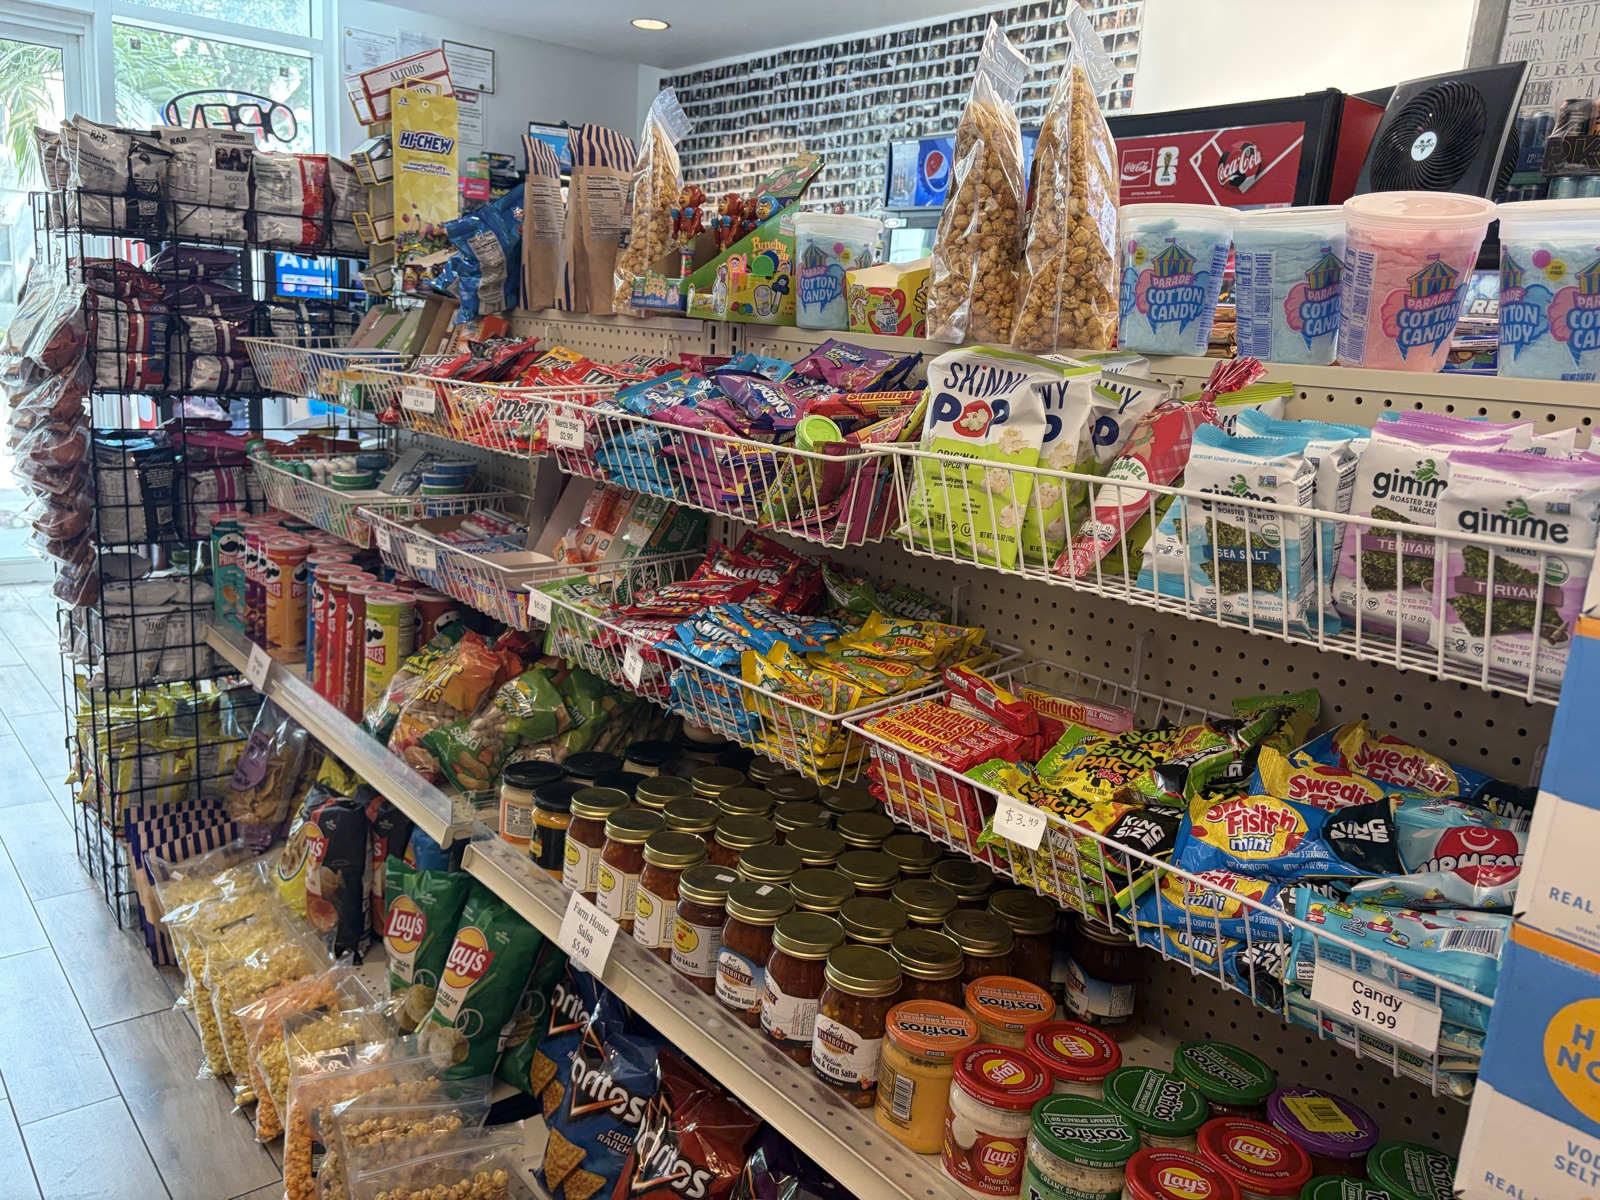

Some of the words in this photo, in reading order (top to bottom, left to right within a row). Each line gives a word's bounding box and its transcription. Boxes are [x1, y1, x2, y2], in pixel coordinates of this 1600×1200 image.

[390, 62, 425, 83] ALTOIDS
[399, 132, 454, 155] HI-CHEW
[1217, 144, 1263, 186] Coca-Cola
[751, 236, 788, 252] Punchy
[802, 267, 826, 277] PARADE
[1153, 275, 1192, 287] PARADE
[801, 276, 837, 290] COTTON
[802, 289, 834, 303] CANDY
[1148, 287, 1204, 305] COTTON
[1407, 291, 1451, 310] PARADE
[1151, 303, 1197, 321] CANDY
[1399, 302, 1459, 328] COTTON
[1402, 322, 1452, 346] CANDY
[846, 390, 914, 402] Starburst
[554, 418, 568, 429] Nerds
[568, 422, 579, 433] Bag
[559, 431, 574, 442] $2.99
[1192, 453, 1213, 461] EXCELLENT
[1371, 467, 1449, 499] gimm
[1452, 473, 1483, 481] EXCELLENT
[1389, 494, 1422, 506] ROASTED
[1408, 504, 1436, 516] SNACKS
[1458, 507, 1568, 544] gimme
[1217, 548, 1236, 559] SEA
[713, 559, 781, 584] Skittles
[1492, 644, 1519, 655] CRISPY
[1544, 648, 1566, 659] LIGHT
[853, 657, 913, 676] Starburst
[1496, 656, 1510, 665] NET
[1511, 658, 1523, 667] WT
[1025, 692, 1086, 724] Starburst
[1086, 708, 1100, 718] ALL
[1099, 712, 1116, 723] PINK
[895, 711, 958, 743] Starburst
[927, 703, 990, 733] Starburst
[876, 720, 940, 750] Starburst
[1088, 742, 1158, 771] SOUR
[1096, 768, 1123, 785] Kids
[1081, 784, 1094, 793] About
[1226, 809, 1278, 836] Fish
[1229, 835, 1273, 852] mini
[1287, 850, 1301, 858] About
[1300, 850, 1305, 858] 3
[1304, 850, 1330, 860] SERVINGS
[1282, 863, 1292, 871] NET
[1308, 863, 1315, 871] OZ
[1315, 862, 1330, 872] (96g)
[1549, 887, 1593, 913] REAL
[388, 907, 423, 942] Lay's
[573, 900, 589, 922] Farm
[588, 913, 610, 938] House
[576, 923, 594, 945] Salsa
[445, 937, 486, 976] Lay's
[571, 939, 590, 959] $5.49
[682, 956, 699, 970] SALSA
[727, 992, 741, 1003] Bacon
[741, 996, 755, 1006] Salsa
[1351, 979, 1403, 1012] Candy
[941, 1018, 964, 1026] SALSA
[1351, 1000, 1398, 1029] $1.99
[1074, 1025, 1087, 1034] Dip
[978, 1048, 1002, 1057] French
[1053, 1035, 1088, 1058] Lay's
[821, 1061, 826, 1070] &
[826, 1062, 839, 1076] Corn
[840, 1067, 858, 1080] Salsa
[990, 1060, 1022, 1083] Lay's
[976, 1096, 995, 1106] FLAVORS
[1089, 1117, 1115, 1125] CREAMY
[596, 1133, 632, 1155] RANCH
[607, 1130, 633, 1147] COOL
[982, 1145, 1018, 1168] Lay's
[1233, 1139, 1281, 1162] Lay's
[1074, 1156, 1089, 1165] MADE
[1089, 1159, 1103, 1167] WITH
[1221, 1153, 1248, 1172] French
[1249, 1168, 1276, 1179] Onion
[1274, 1170, 1291, 1180] Dip
[978, 1180, 1002, 1191] Onion
[1002, 1184, 1015, 1196] Dip
[984, 1175, 1010, 1186] French
[1039, 1173, 1065, 1193] CREAMY
[1065, 1187, 1095, 1200] SPINACH
[1164, 1172, 1207, 1193] Lay's
[1485, 1171, 1531, 1200] REAL
